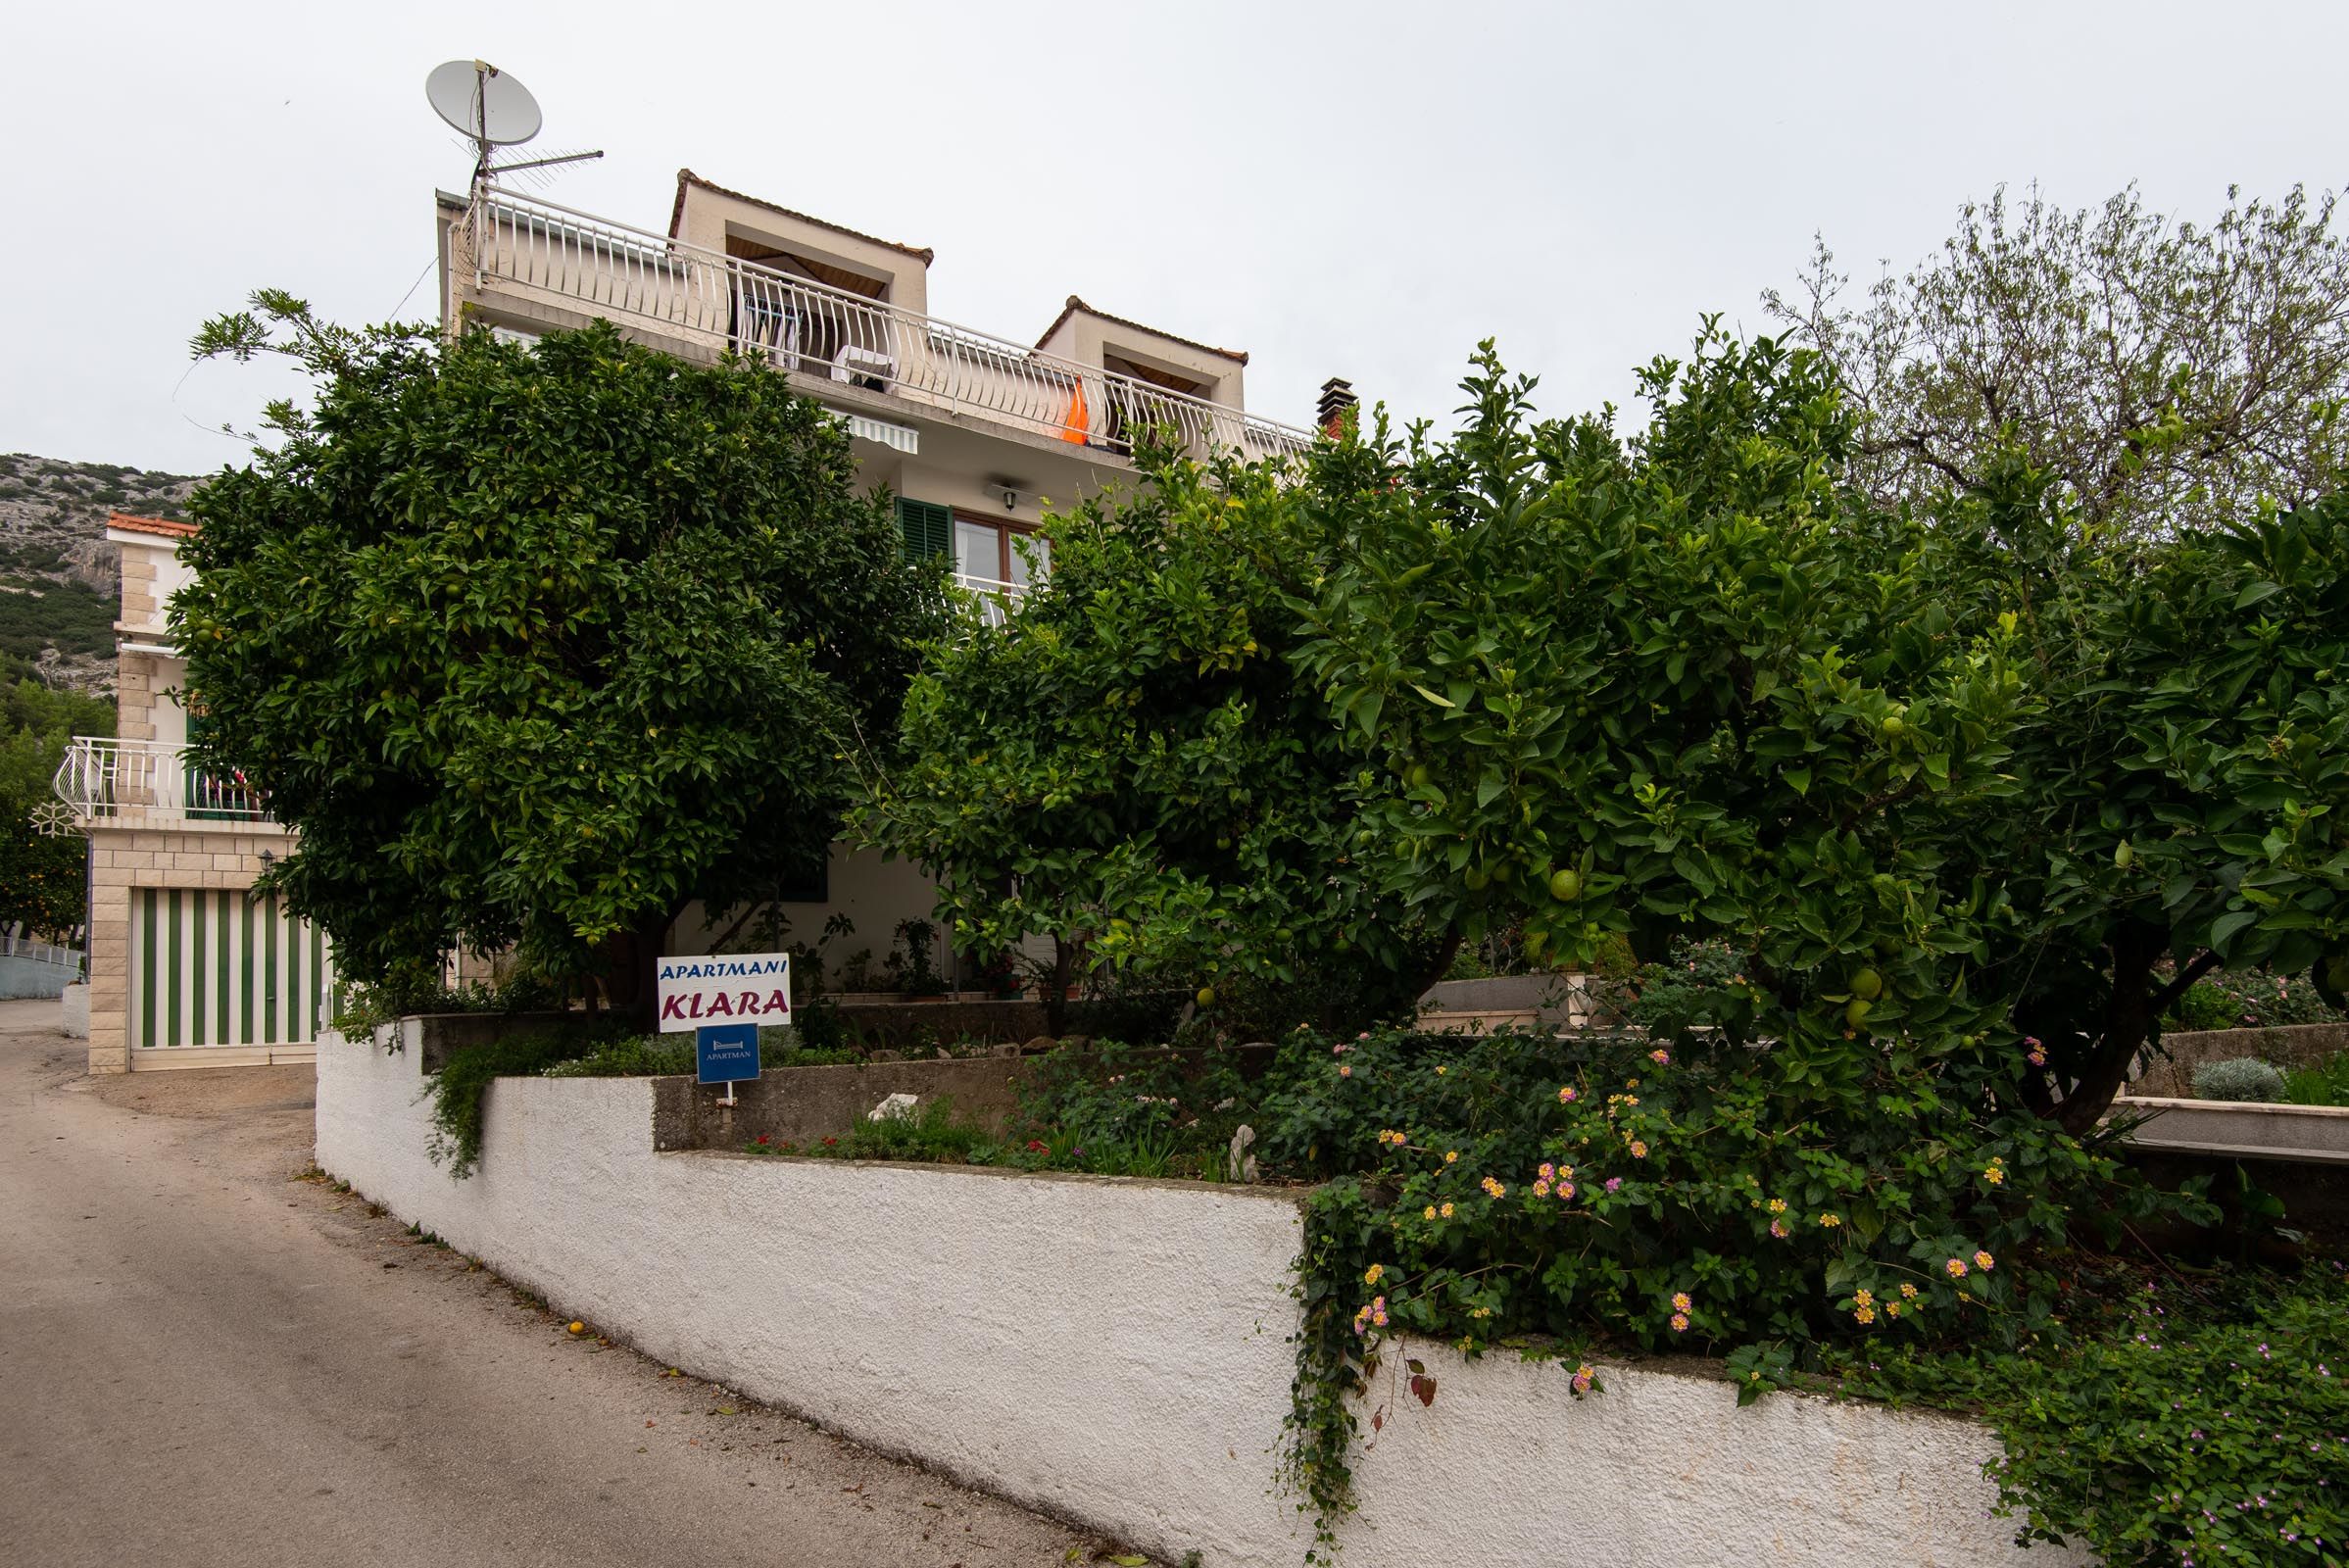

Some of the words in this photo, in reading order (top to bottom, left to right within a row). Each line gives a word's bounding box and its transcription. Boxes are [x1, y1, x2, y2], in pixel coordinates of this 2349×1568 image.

[660, 960, 787, 980] APARTMANI
[661, 990, 789, 1020] KLARA
[706, 1051, 752, 1060] APARTMAN
